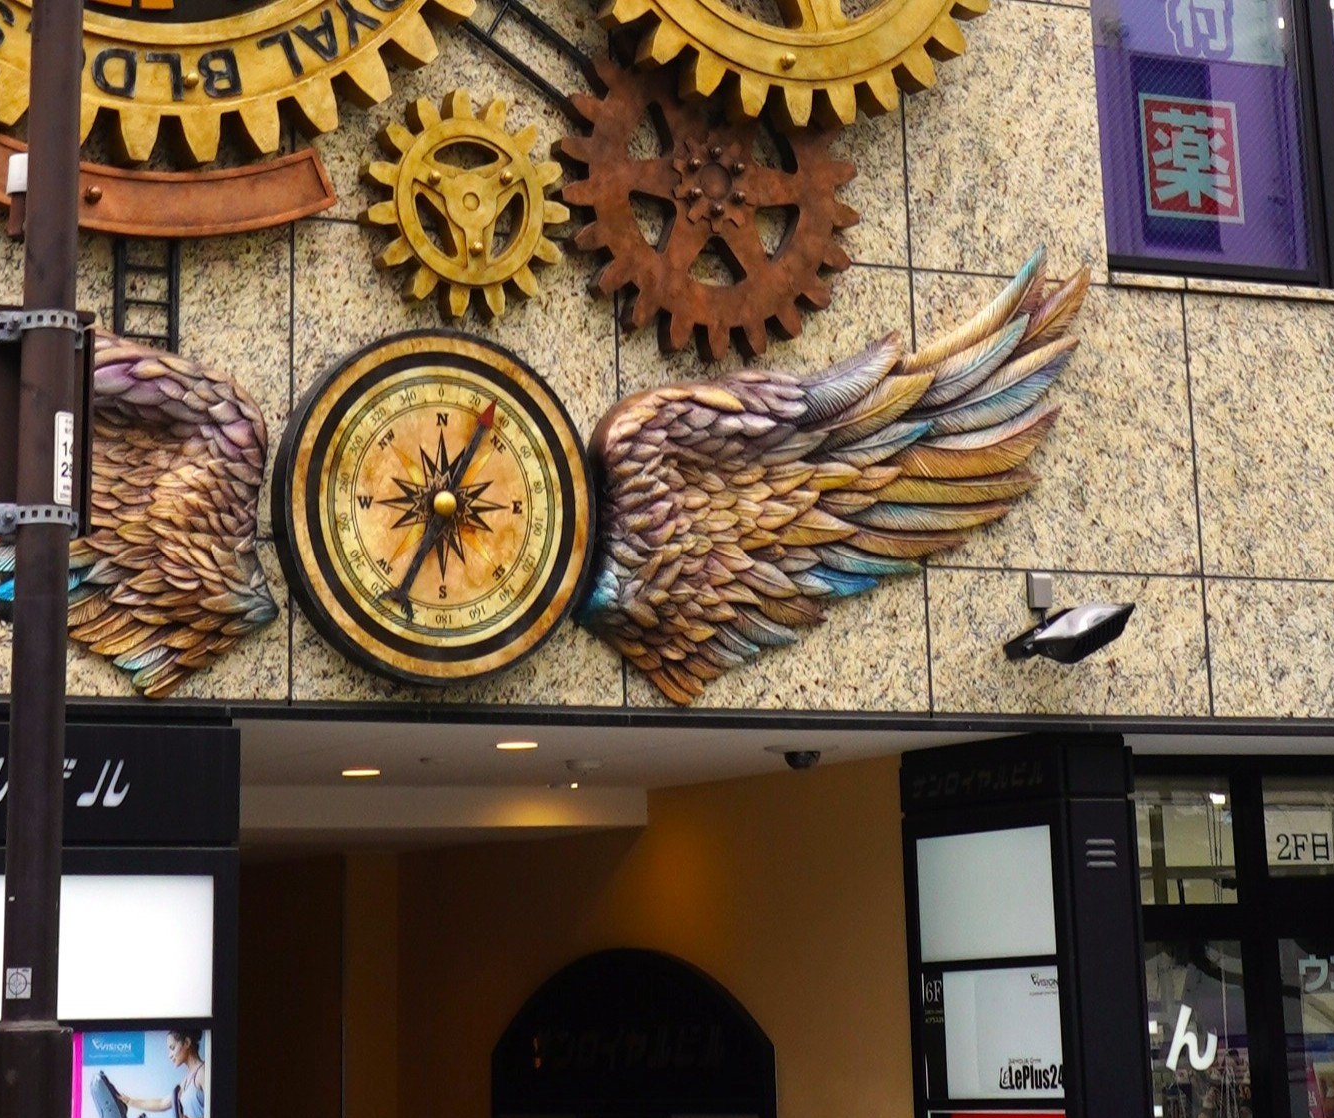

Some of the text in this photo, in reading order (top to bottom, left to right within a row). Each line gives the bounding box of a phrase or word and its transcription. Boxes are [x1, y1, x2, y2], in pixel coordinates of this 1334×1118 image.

[84, 46, 244, 100] BLD
[1150, 108, 1233, 209] 薬
[436, 413, 449, 427] N
[356, 496, 373, 510] W
[512, 500, 523, 515] E
[438, 585, 448, 599] S
[925, 980, 943, 1003] 6F
